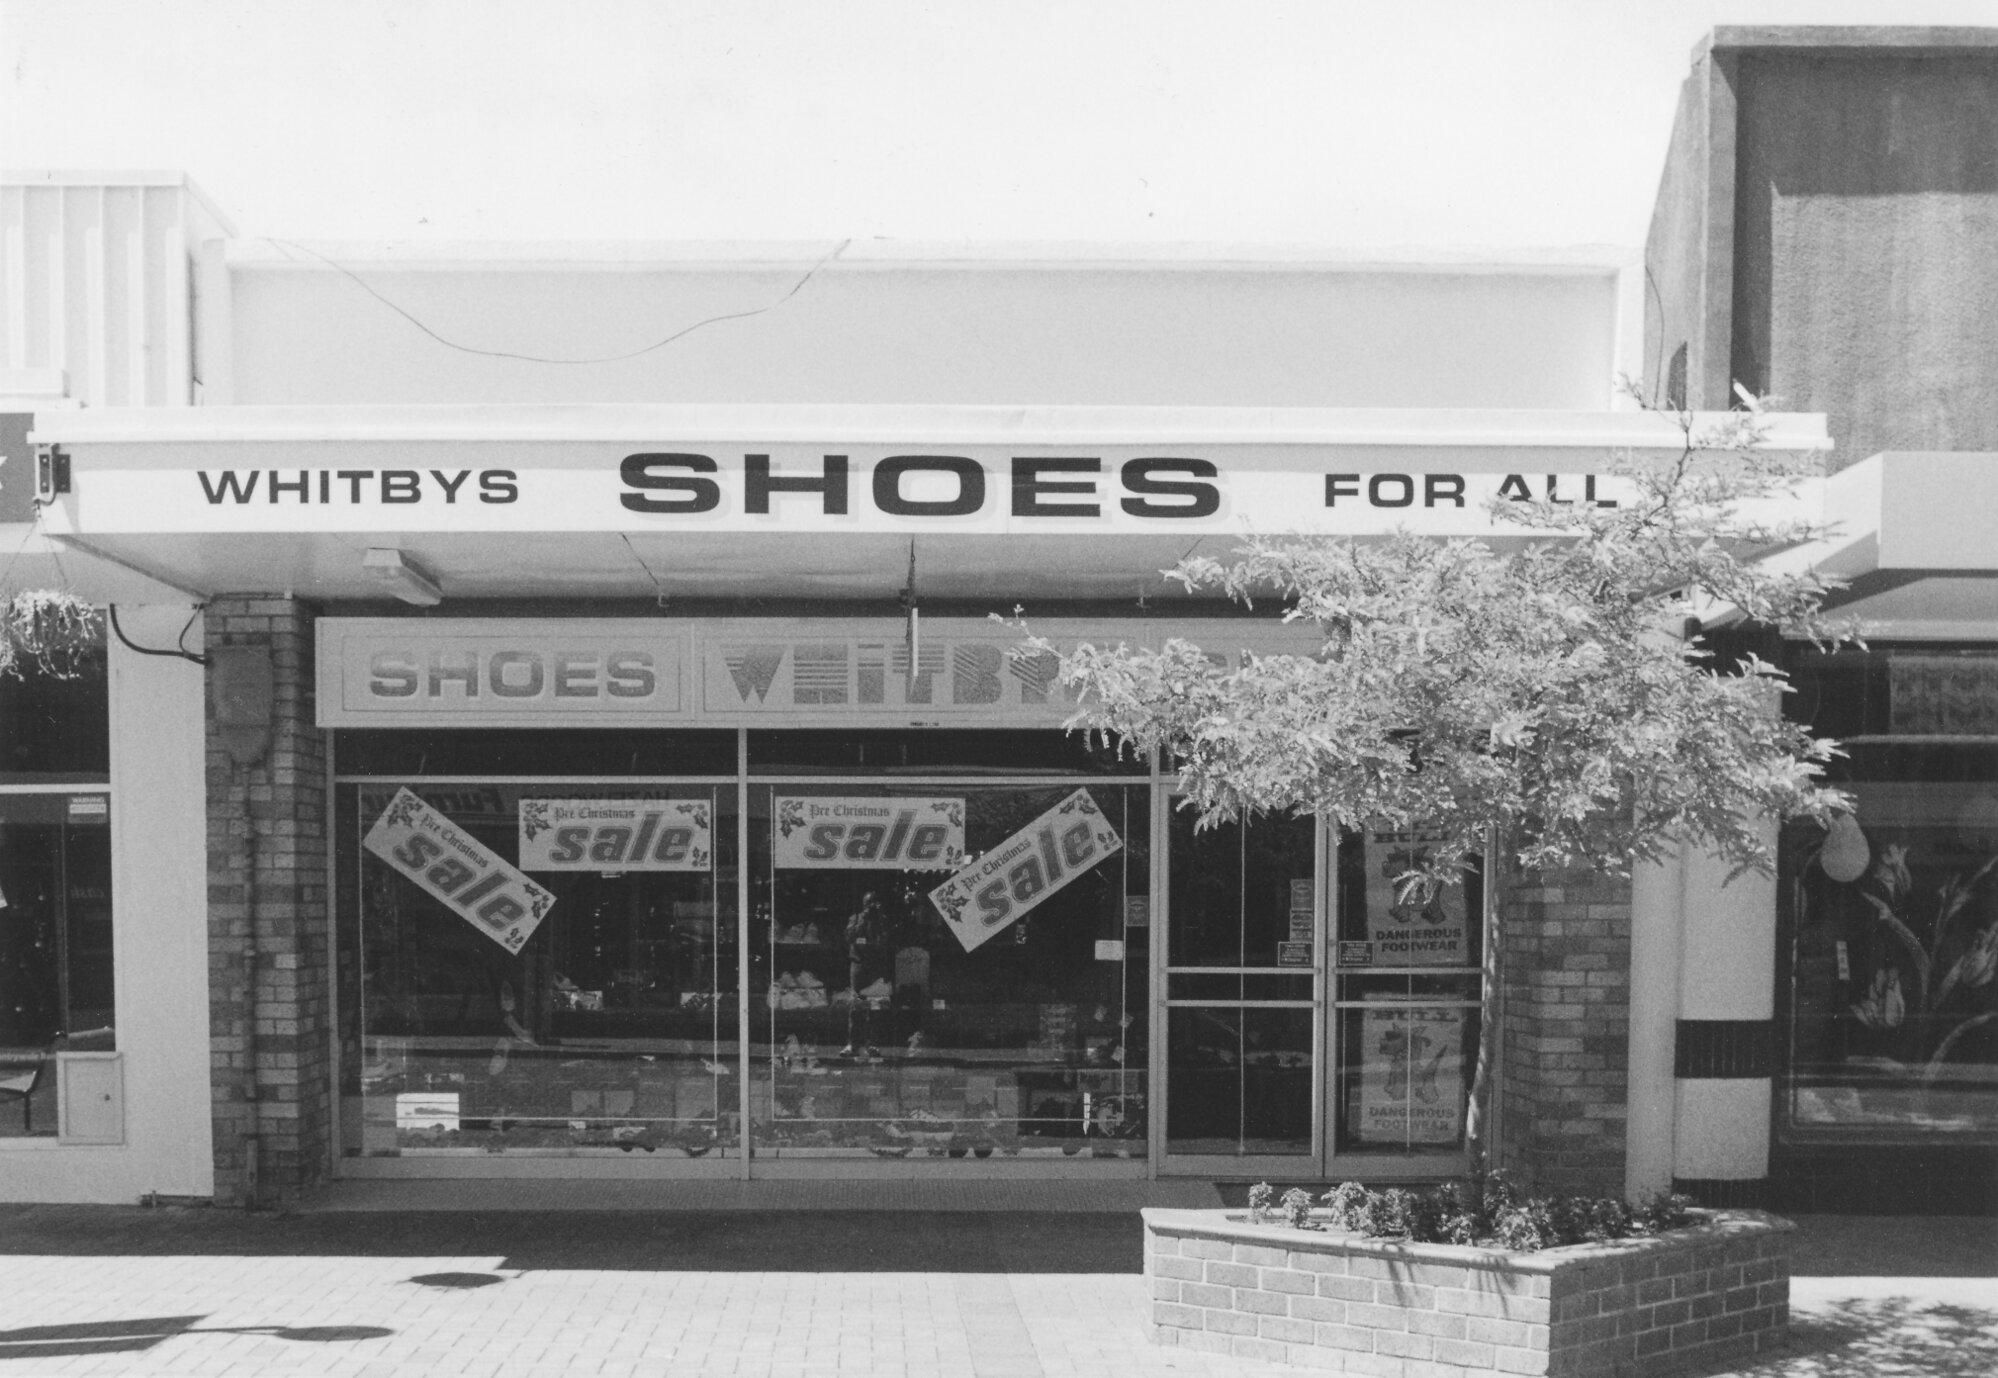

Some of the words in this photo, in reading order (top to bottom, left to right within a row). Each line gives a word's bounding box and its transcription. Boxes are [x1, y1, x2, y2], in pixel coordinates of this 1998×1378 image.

[197, 469, 518, 504] WHITBYS
[620, 452, 1220, 519] SHOES
[1325, 474, 1466, 508] FOR
[1496, 474, 1618, 508] ALL
[369, 651, 656, 698] SHOES
[554, 807, 575, 822] Pre
[578, 807, 637, 820] Christmas
[803, 809, 949, 862] sale
[809, 804, 830, 819] Pre
[833, 804, 890, 818] Christmas
[417, 813, 441, 834] Pre
[440, 829, 490, 868] Christmas
[549, 810, 695, 864] sale
[392, 832, 528, 932] sale
[960, 873, 983, 892] Pre
[981, 838, 1033, 876] Christmas
[974, 820, 1097, 928] sale
[1376, 929, 1462, 940] DANGEROUS
[1369, 1107, 1455, 1119] DANGEROUS
